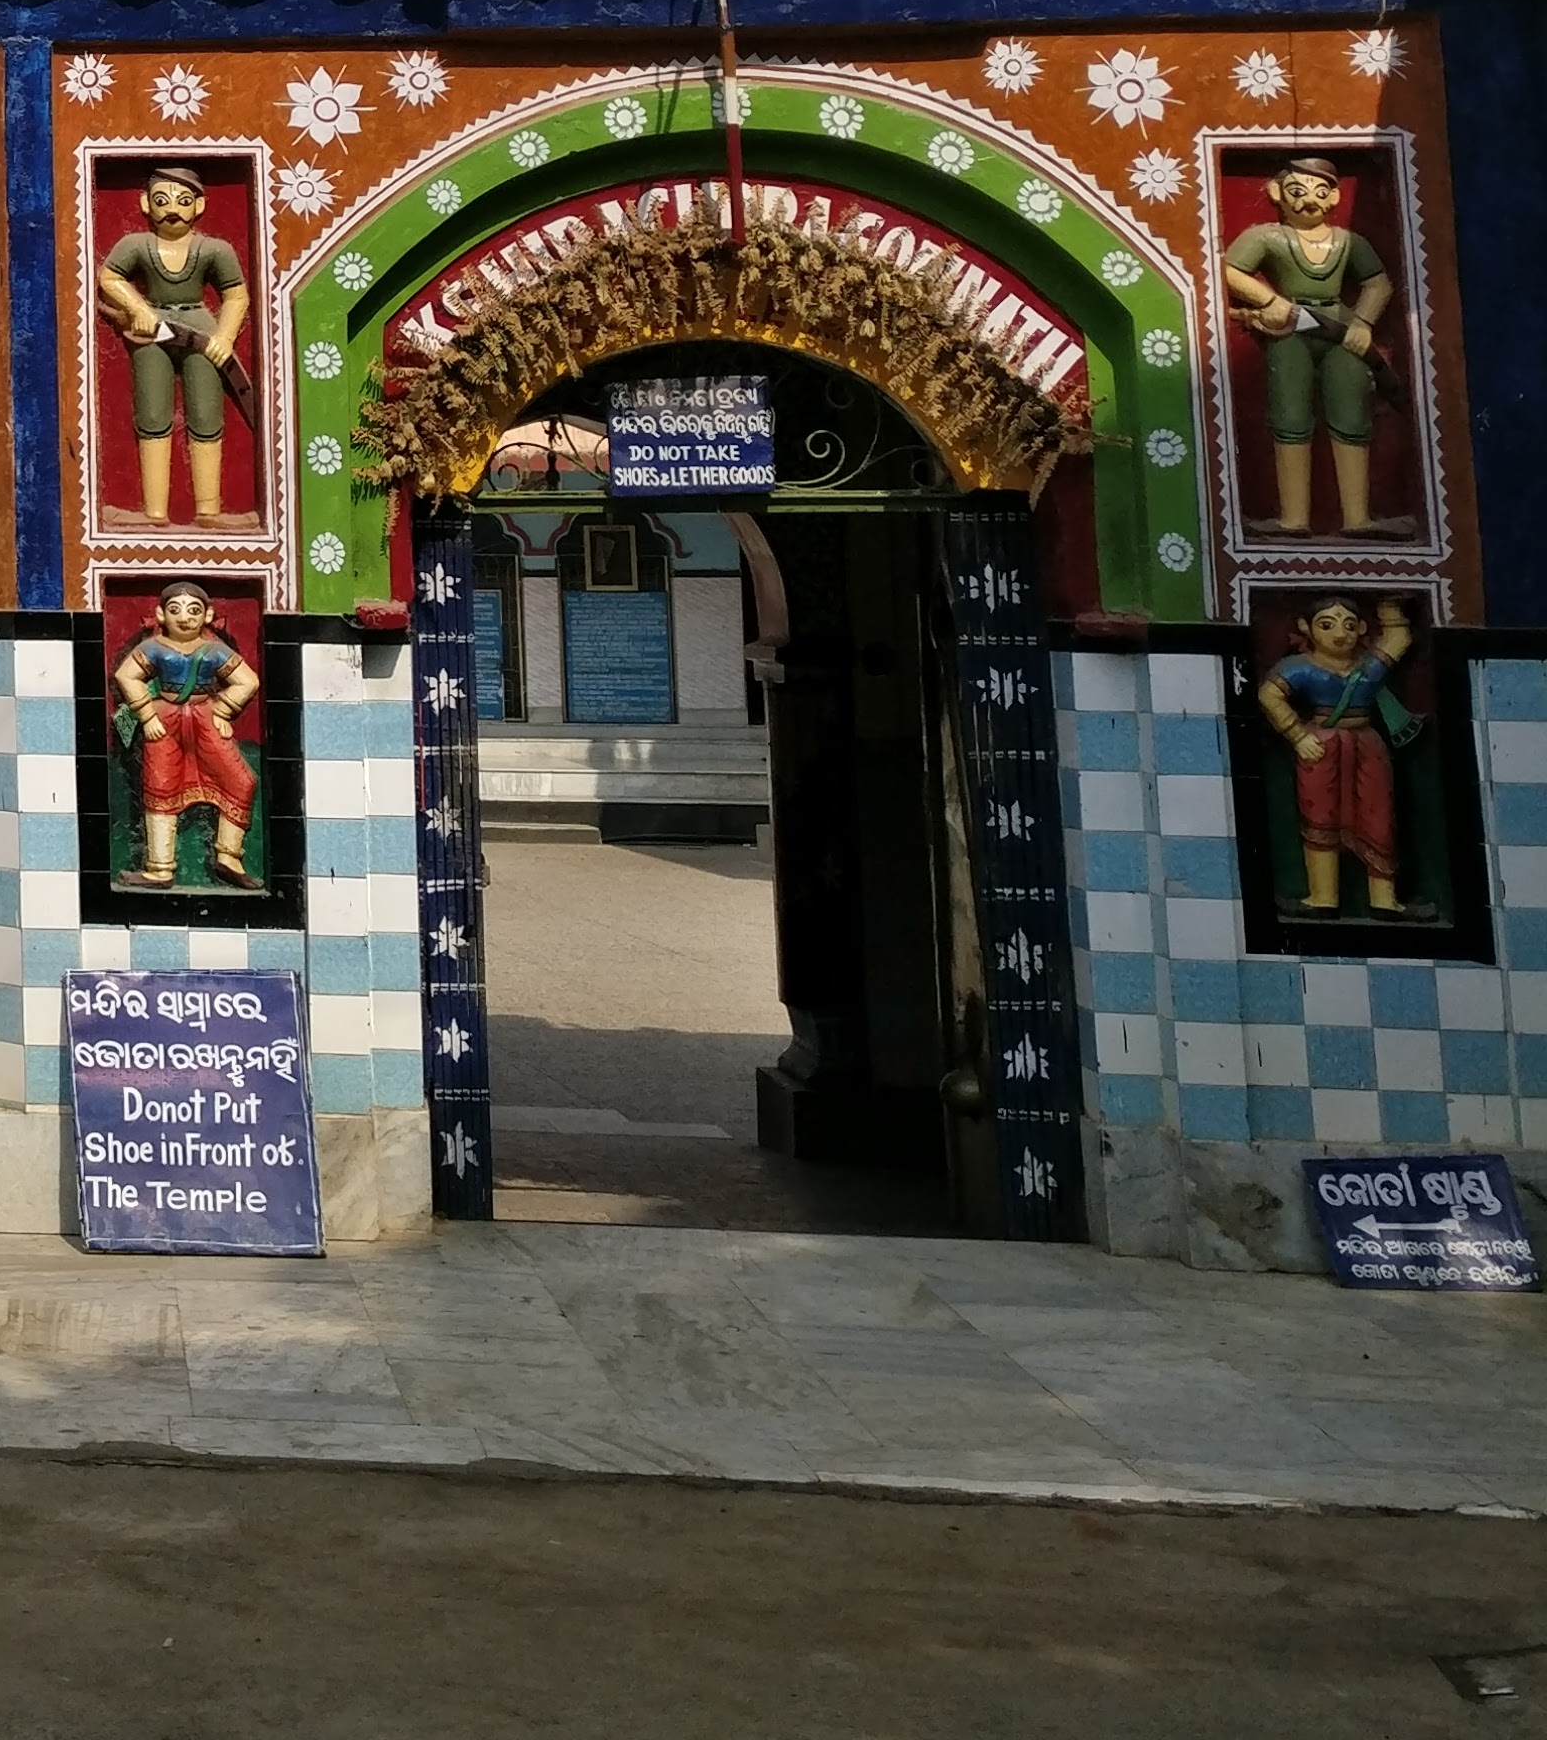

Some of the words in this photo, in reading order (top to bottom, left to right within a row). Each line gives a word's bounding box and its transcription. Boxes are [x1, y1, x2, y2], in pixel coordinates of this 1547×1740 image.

[629, 446, 655, 461] DO
[659, 446, 691, 461] NOT
[696, 445, 740, 461] TAKE
[615, 466, 659, 486] SHOES
[123, 1087, 206, 1124] Donot
[214, 1091, 262, 1124] Put
[85, 1132, 154, 1163] Shoe
[85, 1176, 139, 1209] The
[146, 1181, 267, 1212] Temple
